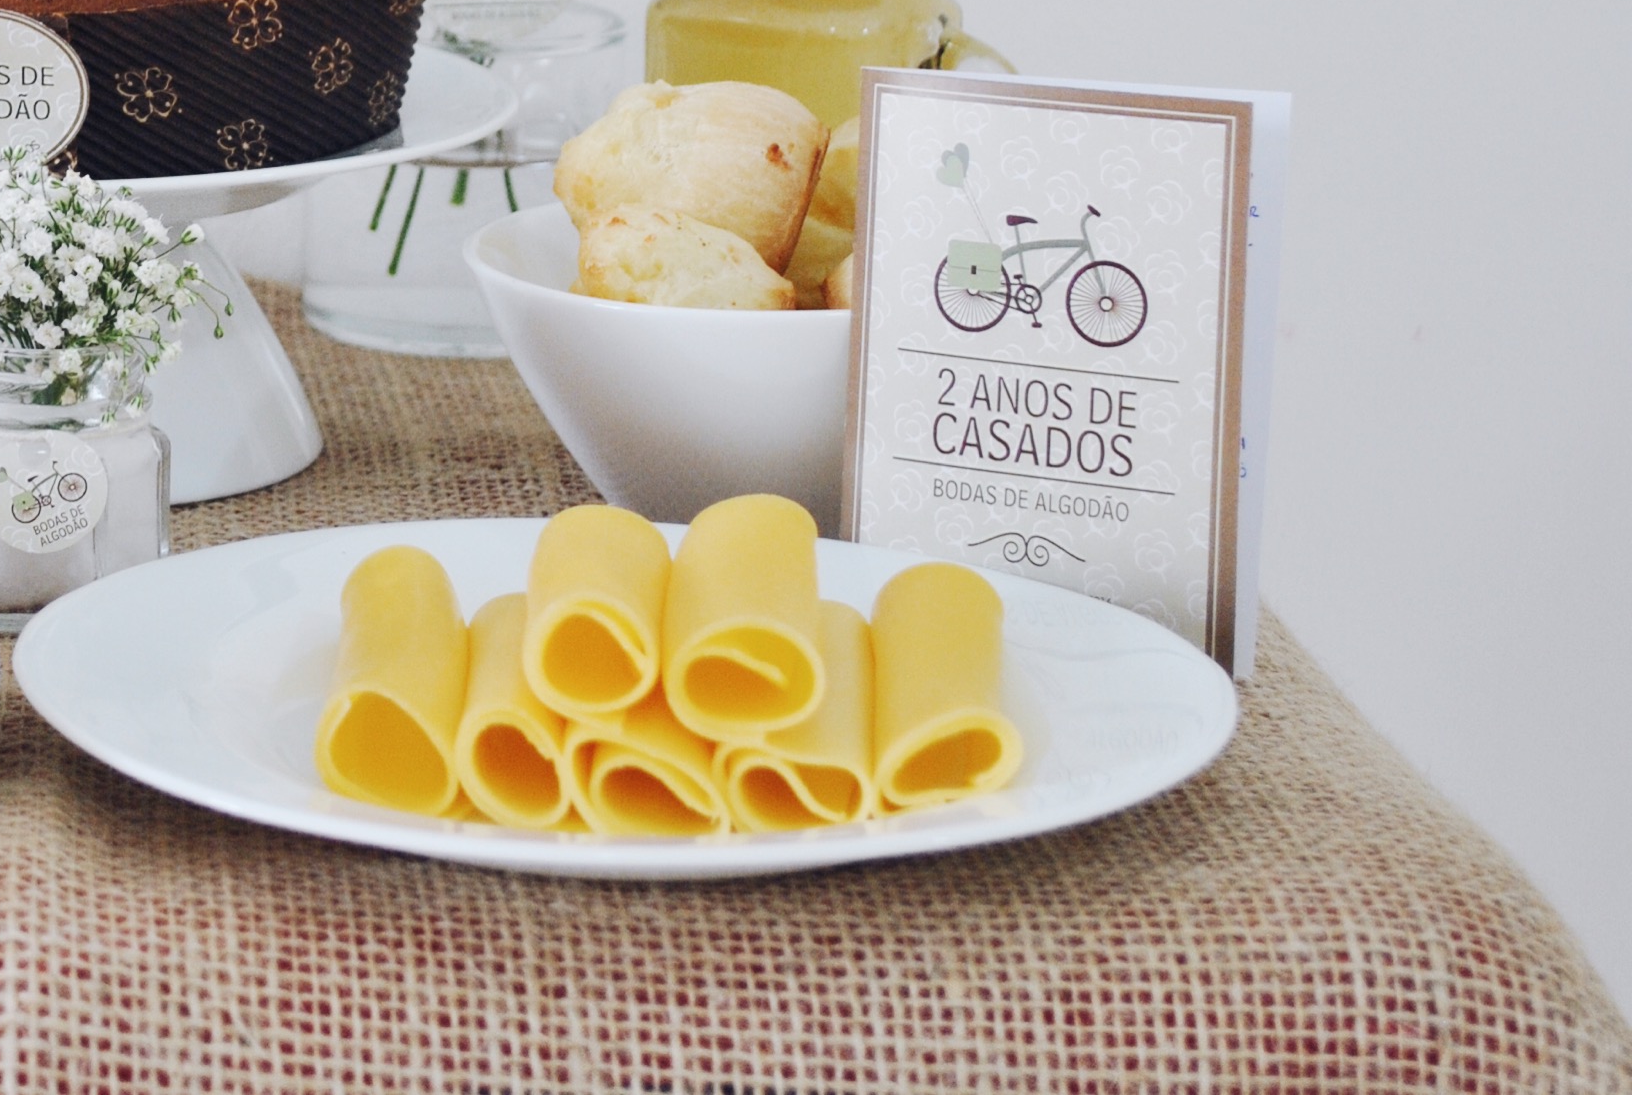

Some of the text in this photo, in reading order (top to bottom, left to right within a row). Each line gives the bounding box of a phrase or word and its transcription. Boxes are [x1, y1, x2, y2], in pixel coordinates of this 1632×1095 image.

[21, 66, 55, 86] DE
[937, 368, 1137, 429] 2 ANOS DE
[933, 412, 1132, 477] CASADOS
[933, 478, 1129, 522] BODAS DE ALGODÃO
[32, 505, 86, 536] BODAS DE
[39, 517, 89, 548] ALGODÃO
